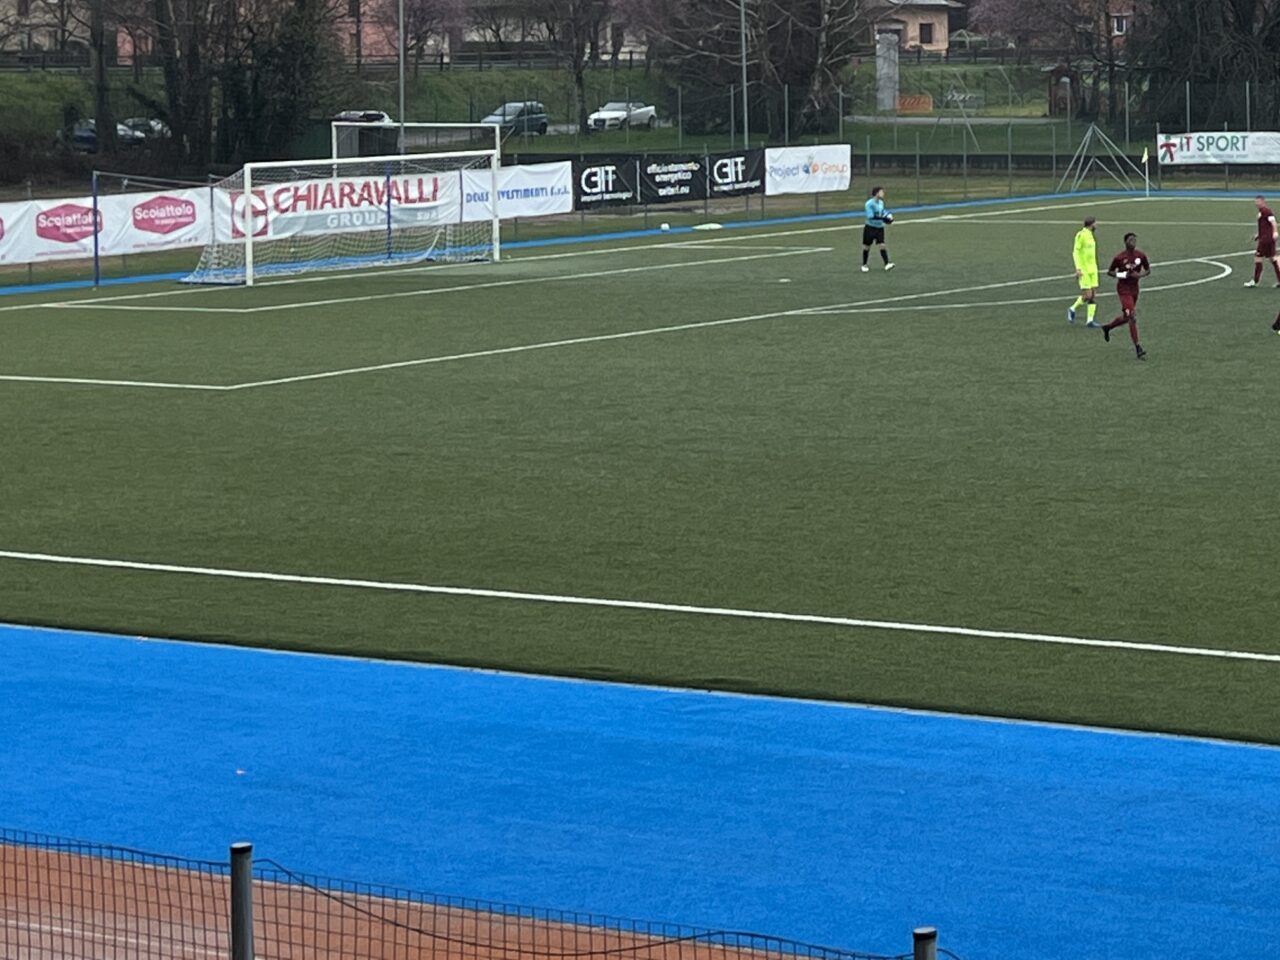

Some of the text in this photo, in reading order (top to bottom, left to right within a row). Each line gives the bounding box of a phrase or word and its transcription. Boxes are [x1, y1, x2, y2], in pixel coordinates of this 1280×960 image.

[1197, 135, 1248, 152] SPORT
[768, 161, 848, 177] Project Group
[272, 177, 439, 214] CHIARAVALLI
[494, 187, 548, 200] VESTIMENTI
[134, 203, 193, 220] Scoiattolo
[327, 211, 386, 228] GROUP
